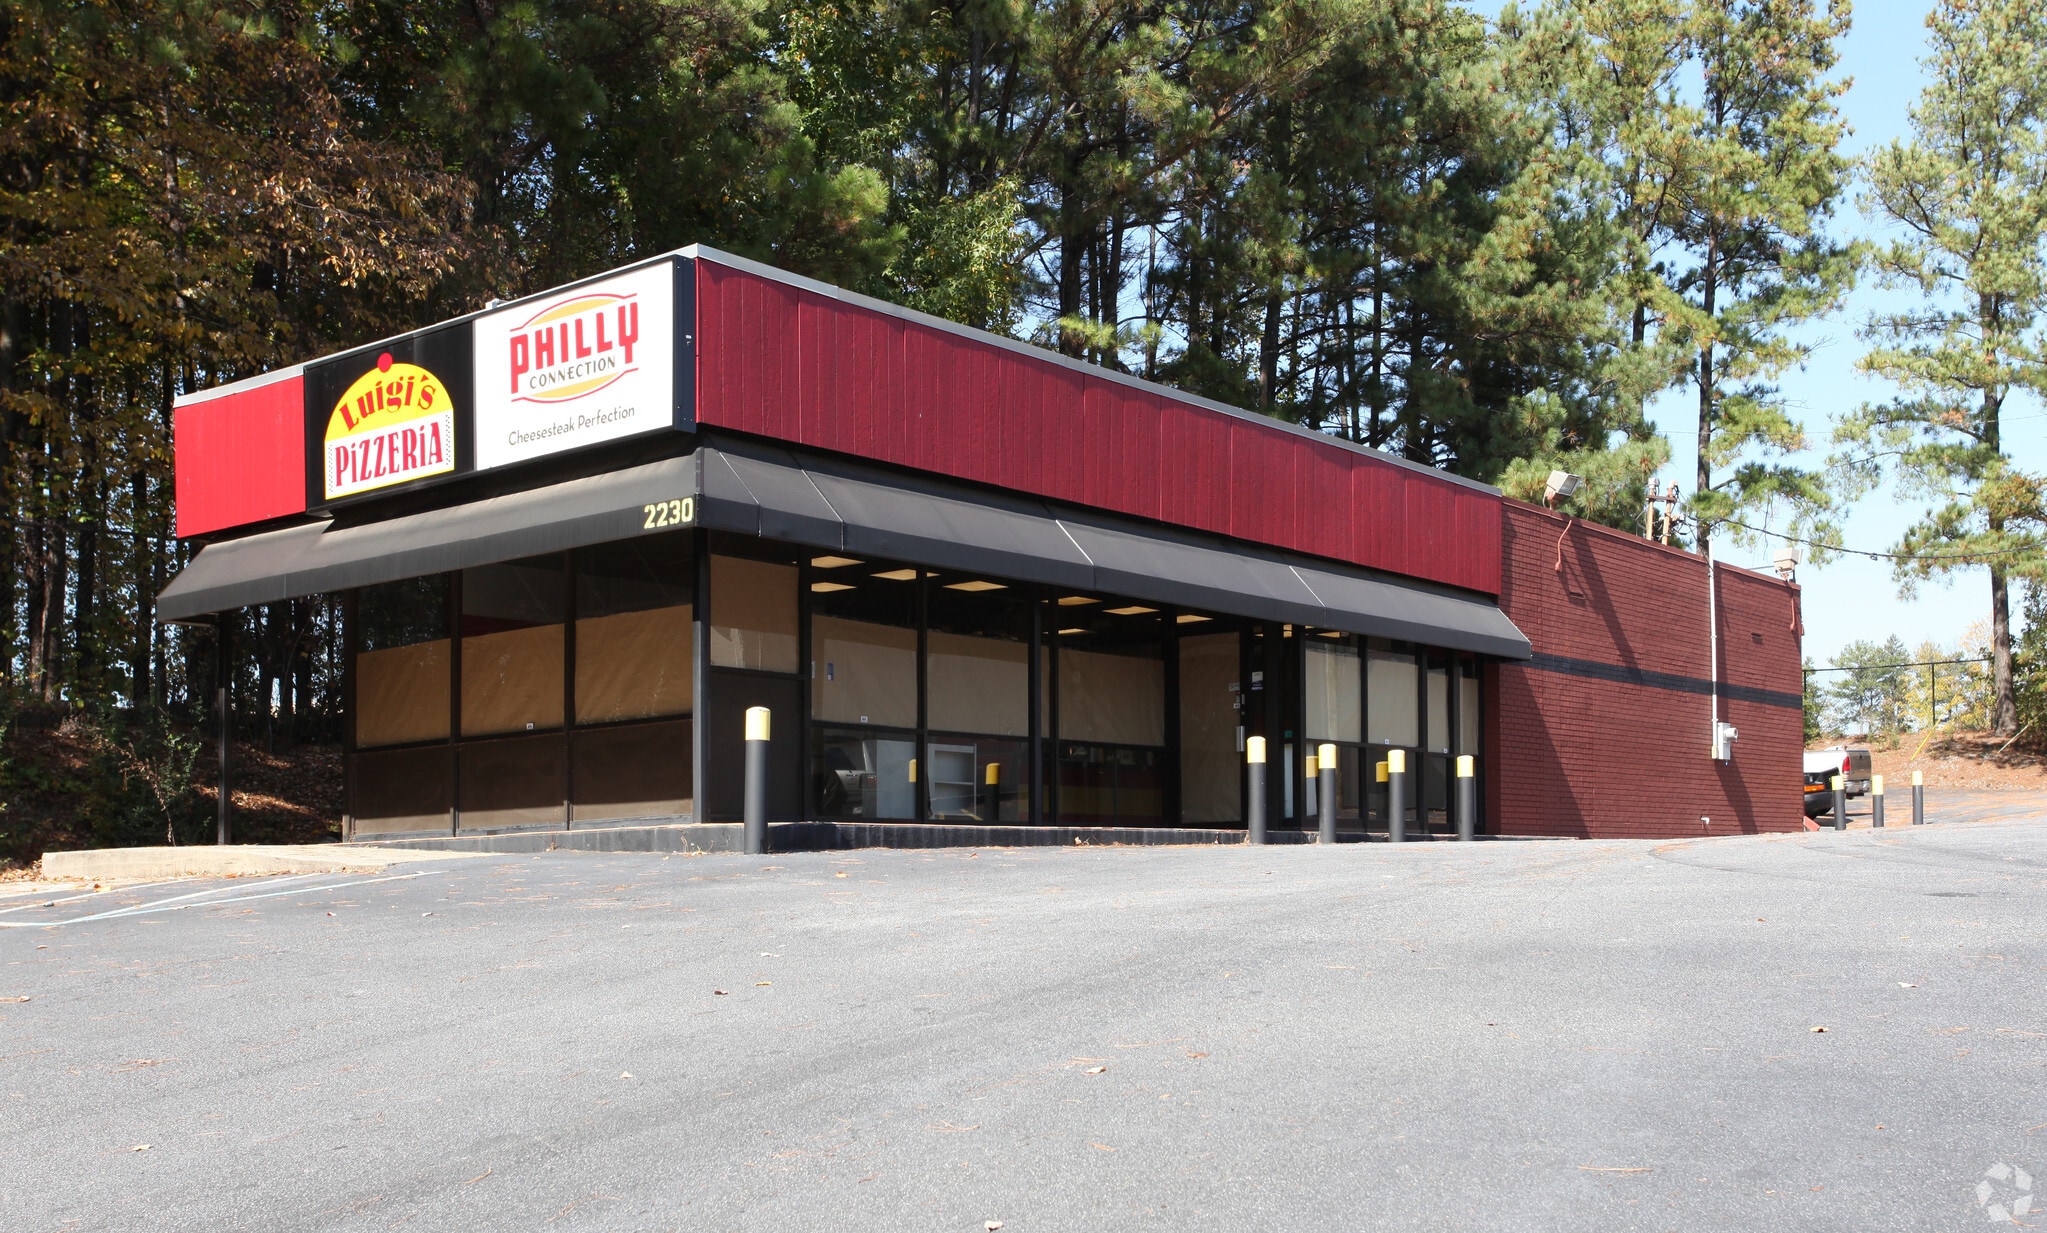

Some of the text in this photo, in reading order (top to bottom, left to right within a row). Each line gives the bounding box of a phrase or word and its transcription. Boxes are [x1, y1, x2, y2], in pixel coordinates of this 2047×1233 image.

[510, 302, 638, 394] PHILLY
[529, 355, 616, 390] CONNECTION
[339, 374, 436, 431] Luigi's
[508, 405, 636, 447] Cheesesteak Perfection
[643, 497, 694, 530] 2230
